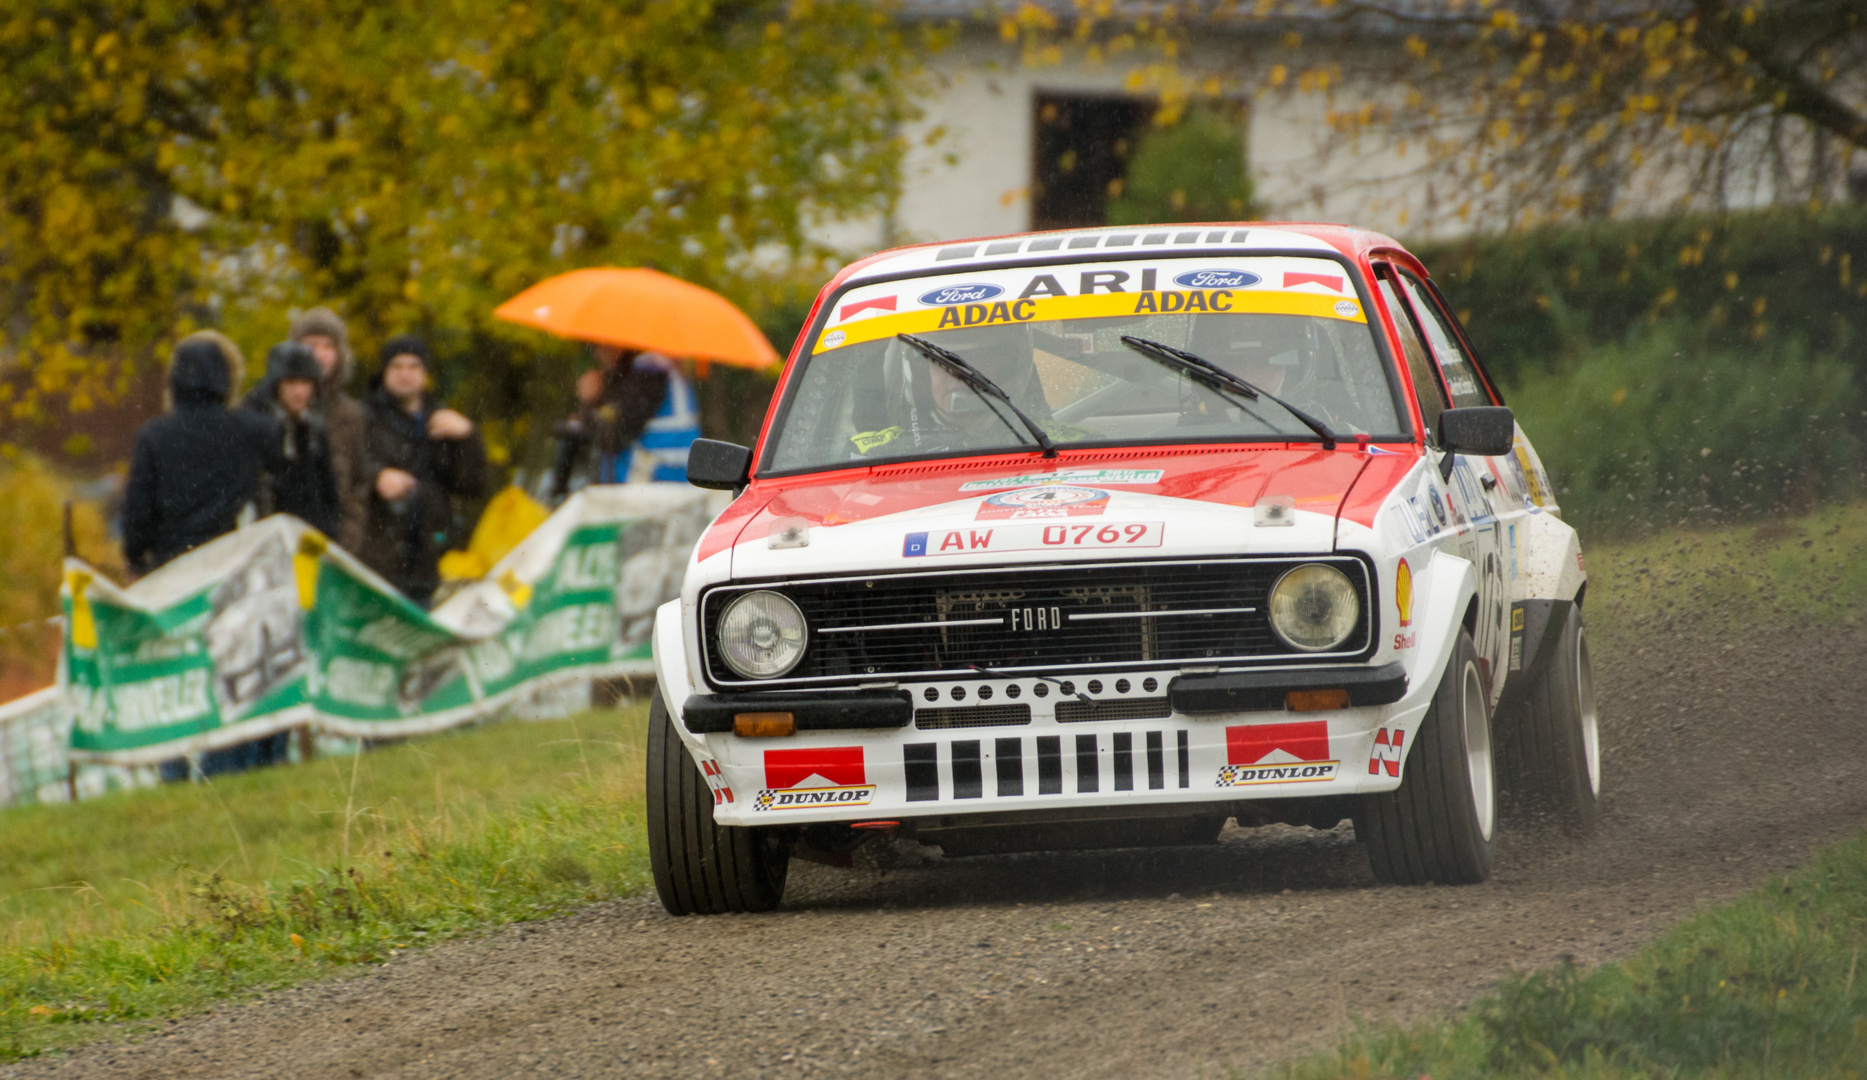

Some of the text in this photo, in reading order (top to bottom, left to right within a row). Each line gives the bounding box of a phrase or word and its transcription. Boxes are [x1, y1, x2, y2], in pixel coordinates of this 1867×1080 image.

[1017, 268, 1157, 300] ARI
[1190, 270, 1243, 288] Ford
[936, 286, 985, 302] Ford
[1134, 290, 1234, 314] ADAC
[937, 299, 1037, 328] ADAC
[1030, 492, 1057, 500] 4
[940, 524, 1148, 551] AW 0769
[911, 544, 921, 552] D
[1011, 607, 1061, 631] FORD
[1393, 631, 1416, 650] Shell
[1239, 765, 1333, 781] DUNLOP
[777, 790, 870, 805] DUNLOP
